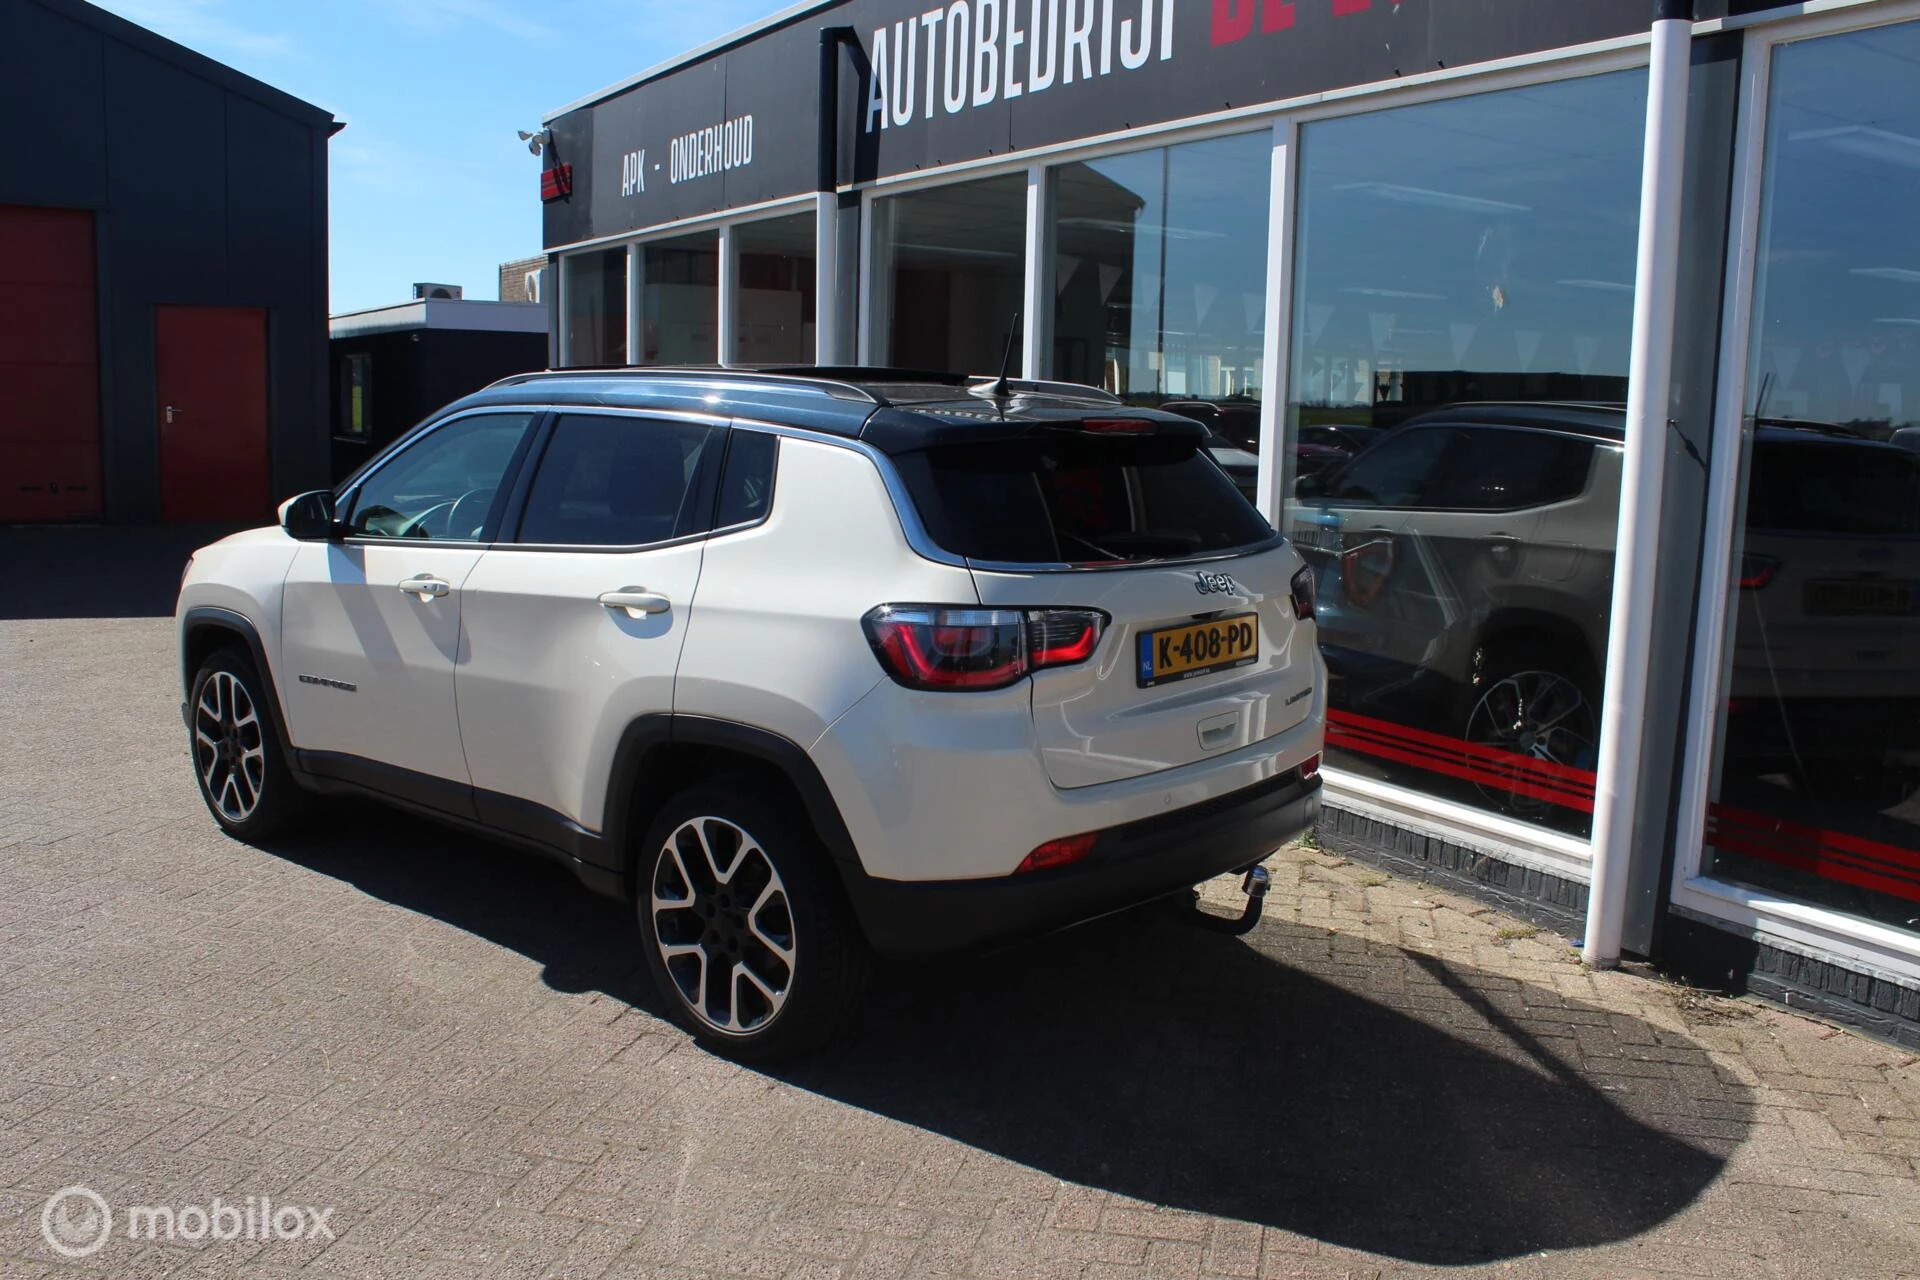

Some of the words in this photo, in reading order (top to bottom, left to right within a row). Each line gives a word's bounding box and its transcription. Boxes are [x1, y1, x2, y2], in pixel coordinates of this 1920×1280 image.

[622, 148, 645, 197] APK
[670, 114, 753, 184] ONDERHOUD
[1195, 571, 1235, 595] Jeep
[1159, 622, 1252, 669] K-408-PD
